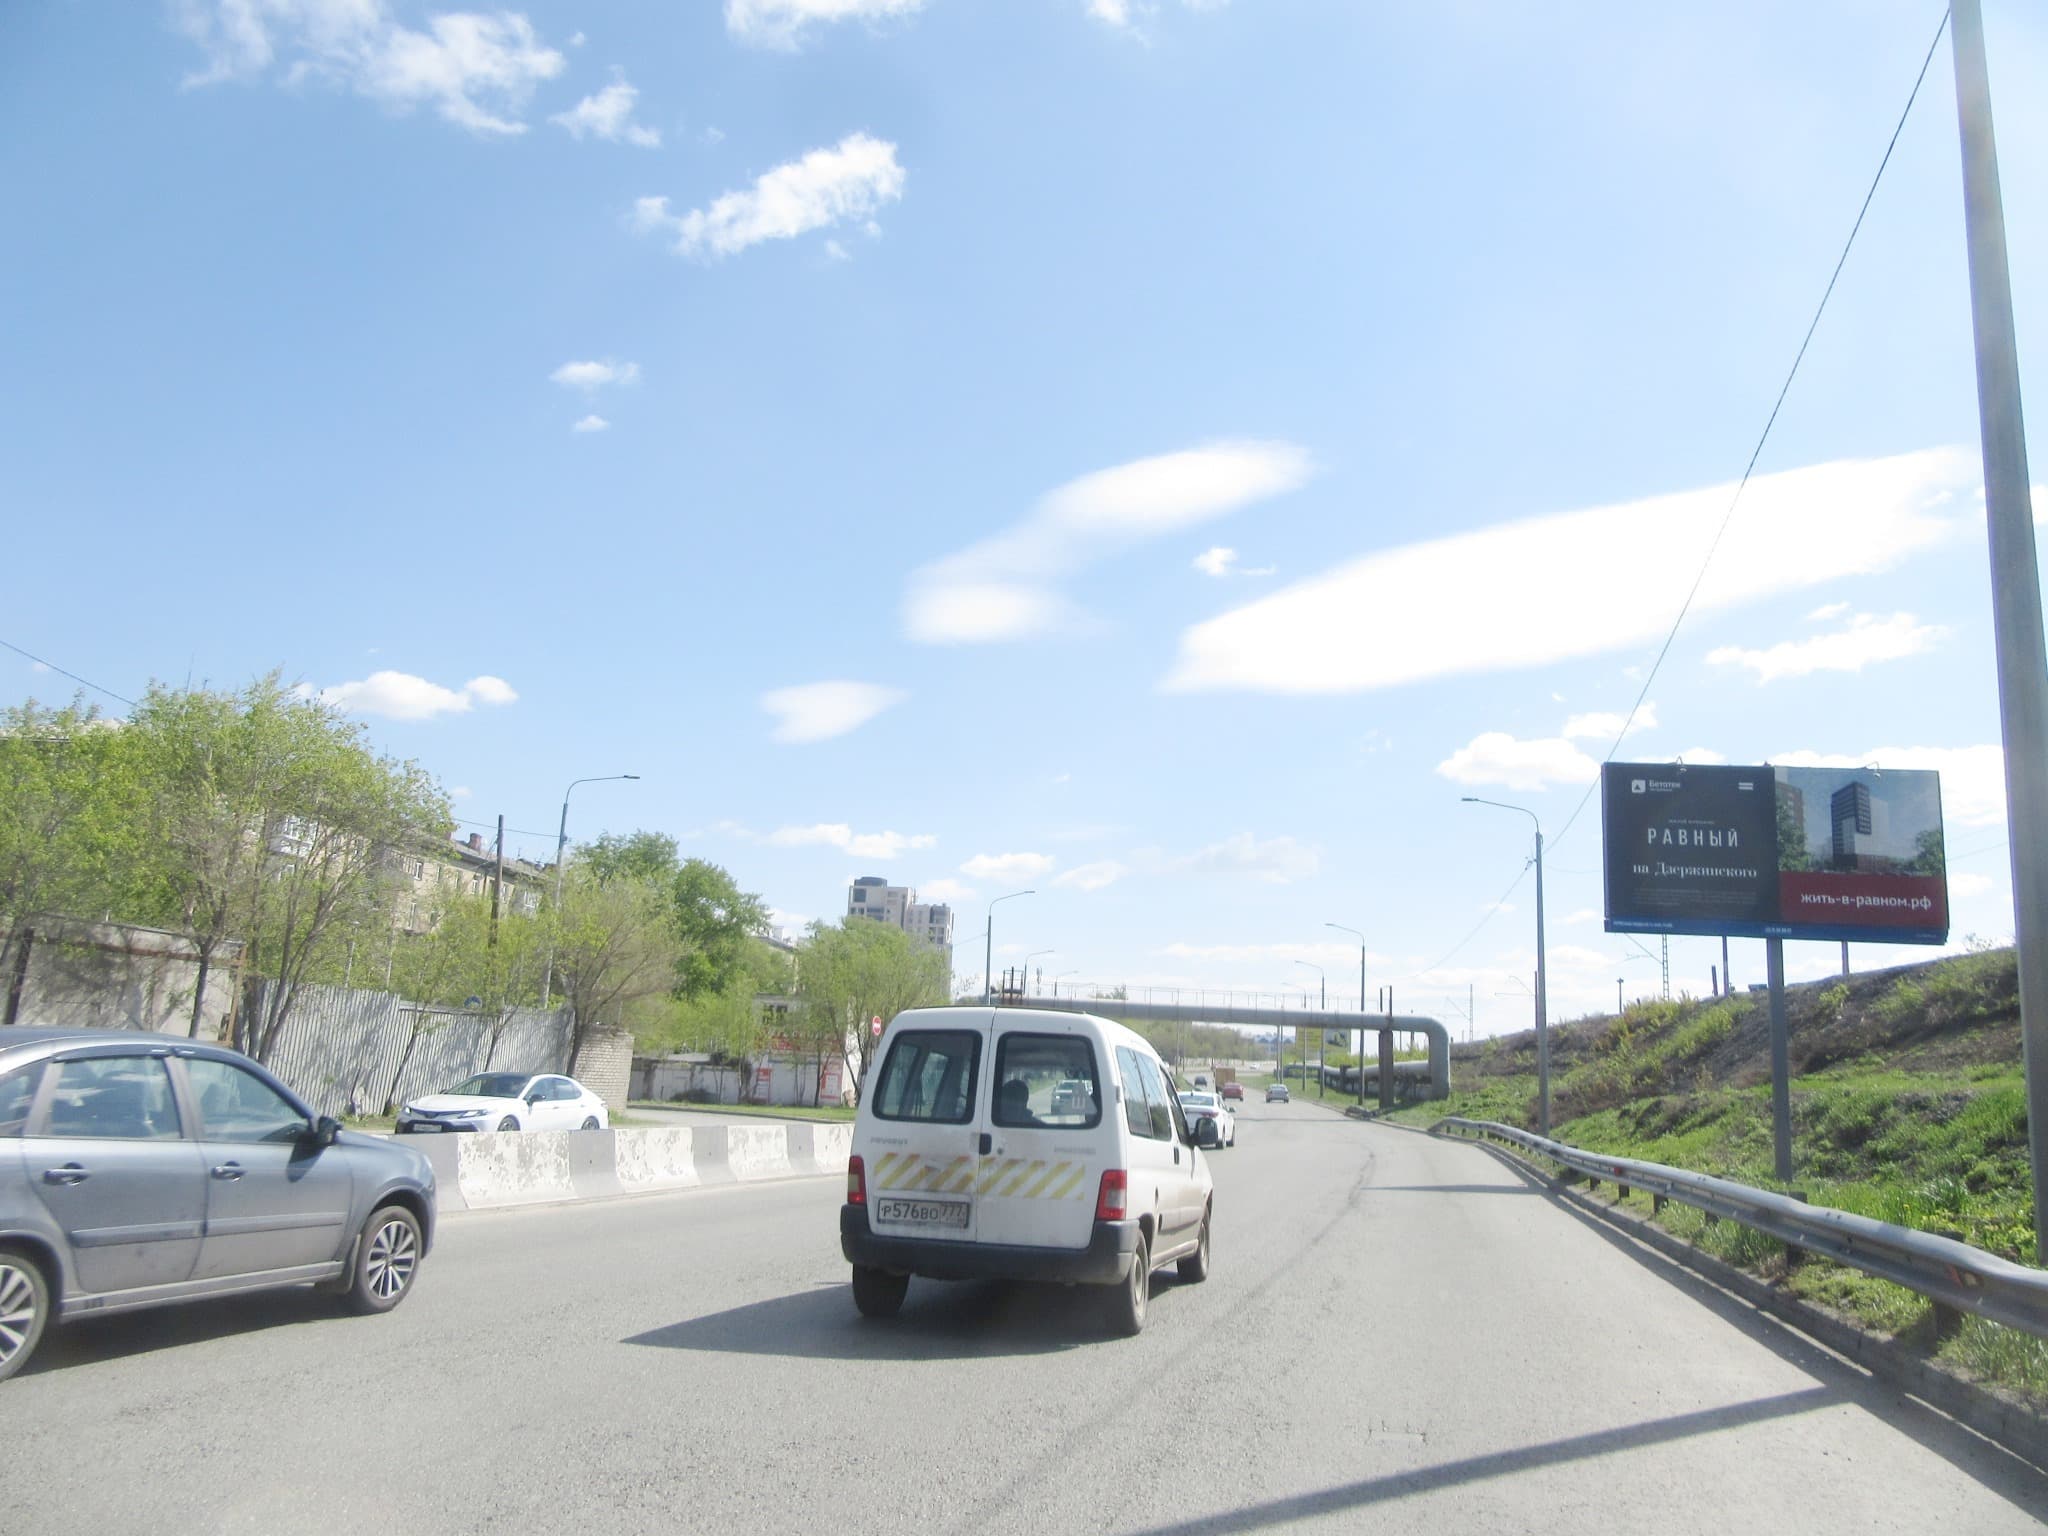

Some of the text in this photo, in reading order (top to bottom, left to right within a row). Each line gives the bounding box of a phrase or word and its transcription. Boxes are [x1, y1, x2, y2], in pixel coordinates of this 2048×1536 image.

[1647, 827, 1739, 848] РАВНЫЙ
[1633, 861, 1758, 879] на Дзержинского
[1800, 892, 1932, 911] жить-в-равном.рф
